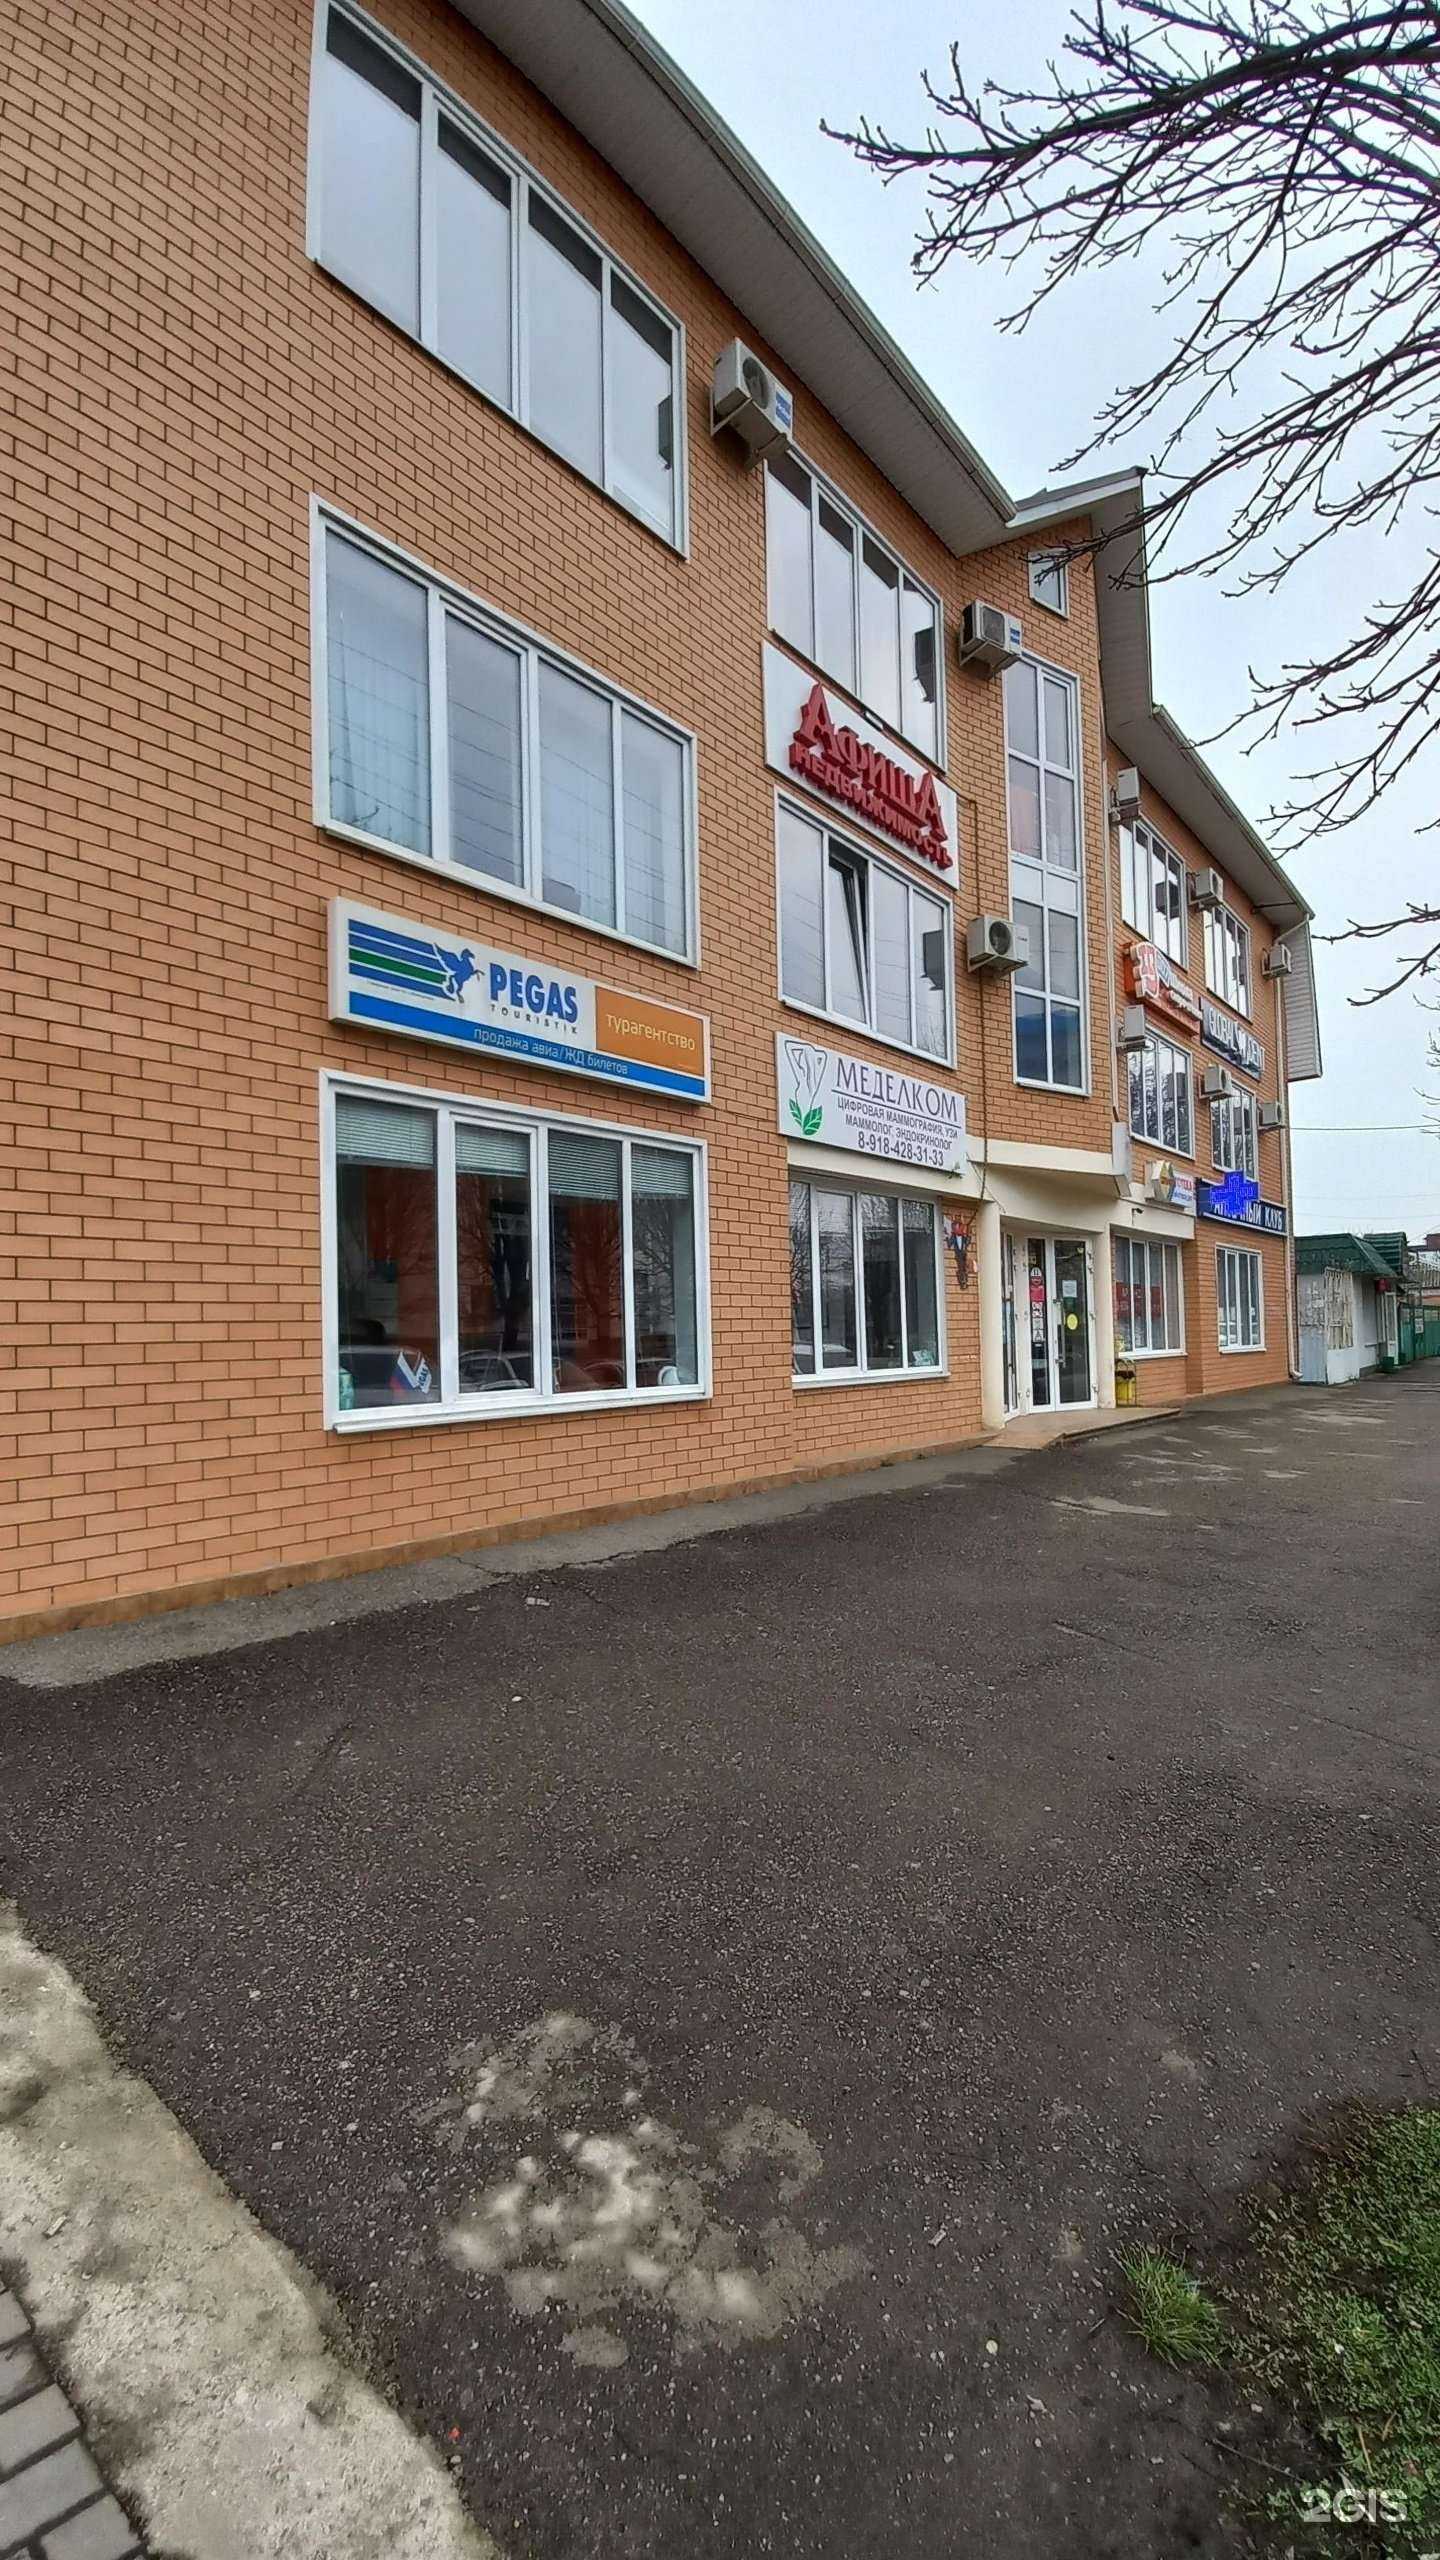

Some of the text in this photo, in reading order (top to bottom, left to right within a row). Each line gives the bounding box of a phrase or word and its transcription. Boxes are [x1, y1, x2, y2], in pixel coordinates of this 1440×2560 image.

[793, 682, 948, 842] АФИША
[788, 741, 954, 870] НЕДВИЖИМОСТЬ
[489, 962, 578, 1023] PEGAS
[489, 1003, 577, 1034] TOURISTIK
[605, 1014, 696, 1050] турагентство
[473, 1028, 628, 1074] продажа авиа/ЖД билетов
[837, 1057, 958, 1122] МЕДЕЛКОМ
[838, 1096, 885, 1120] ЦИФРОВАЯ
[945, 1124, 958, 1139] УЗИ
[858, 1131, 944, 1166] 8-918-428-31-33
[895, 1128, 953, 1151] ЭНДОКРИНОЛОГ
[1264, 1205, 1283, 1230] КЛУБ
